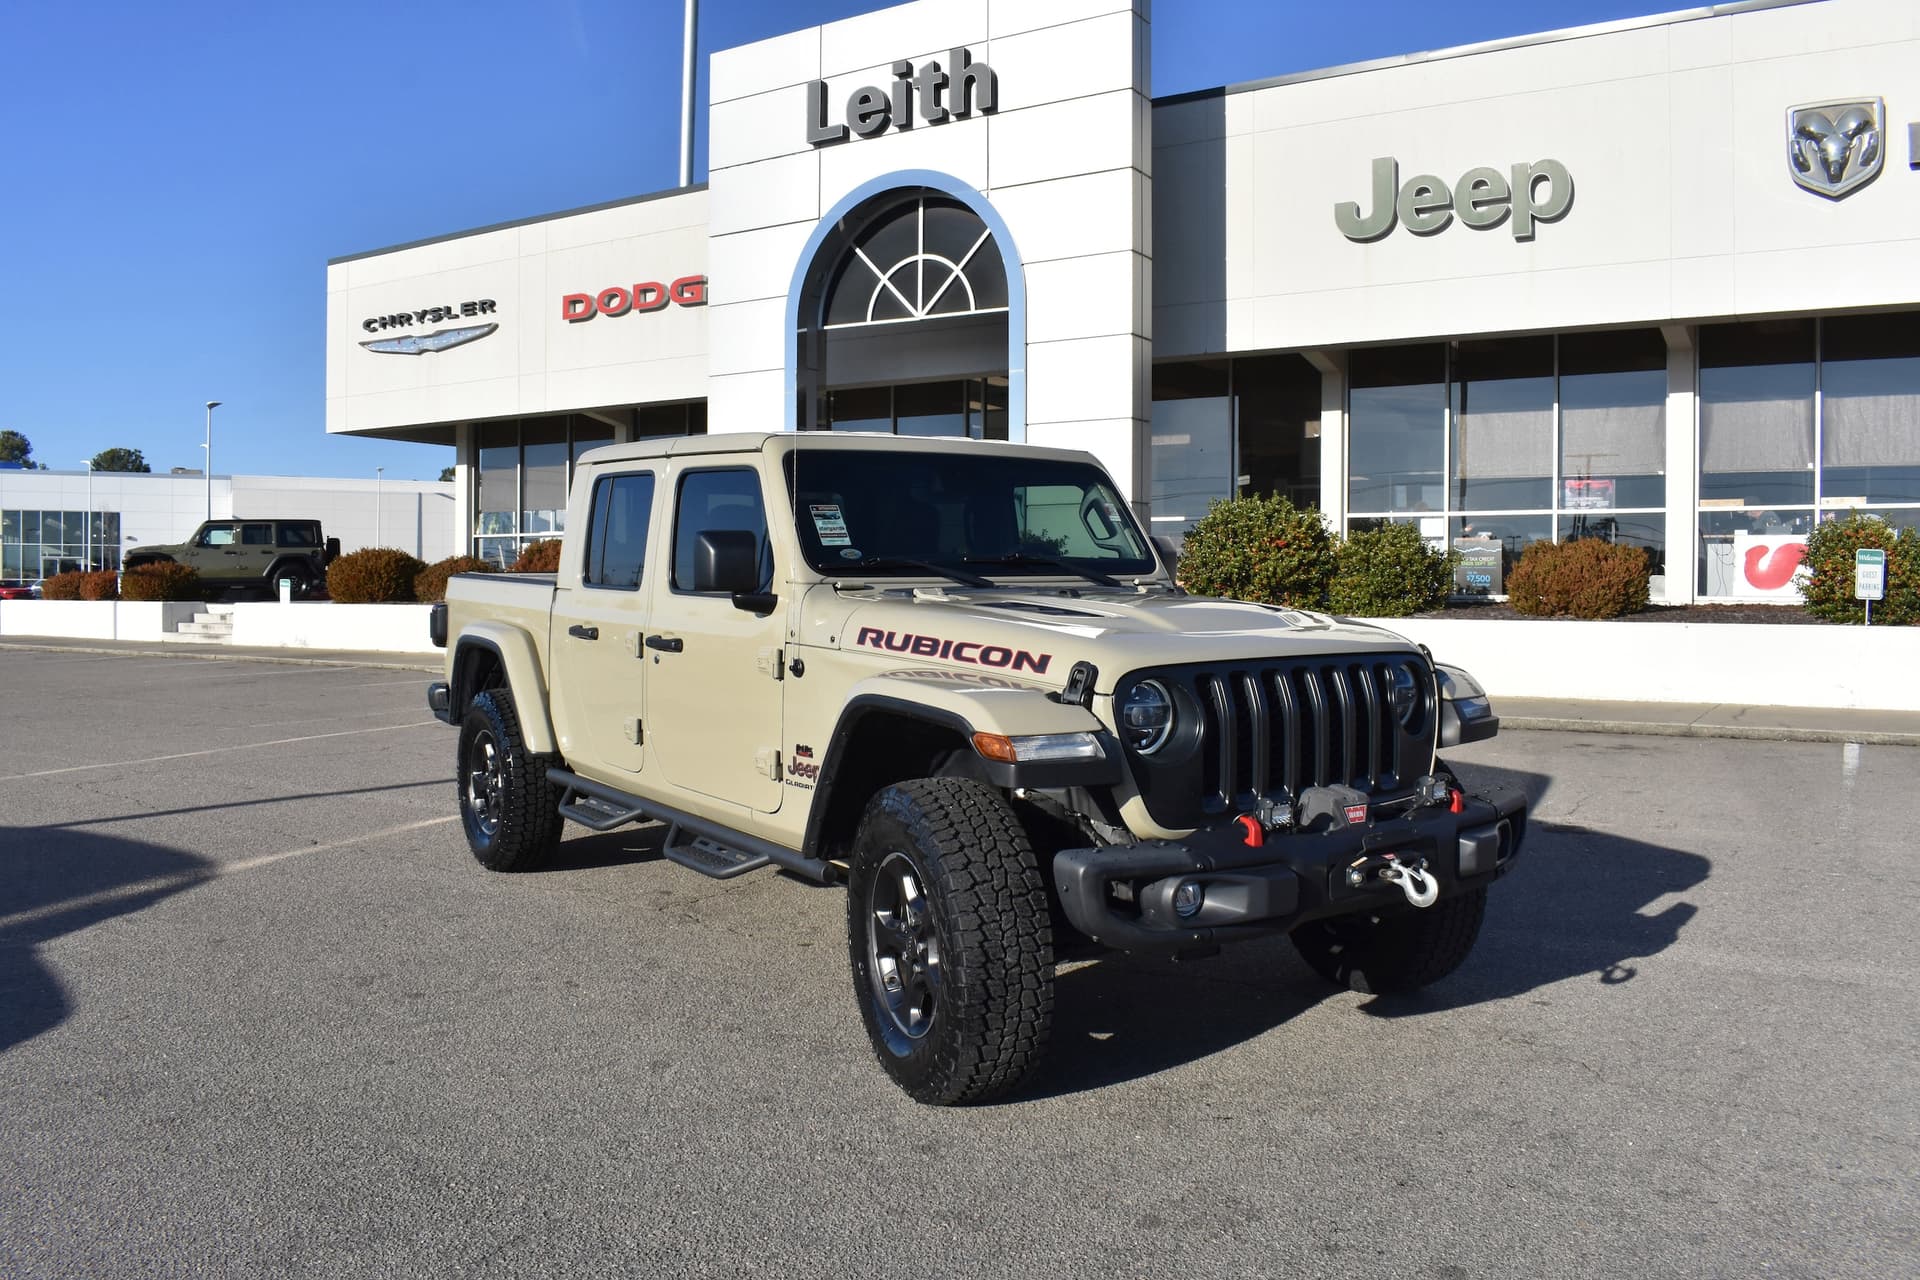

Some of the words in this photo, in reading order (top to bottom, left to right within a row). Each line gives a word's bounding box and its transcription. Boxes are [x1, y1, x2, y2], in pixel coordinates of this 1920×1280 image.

[806, 47, 998, 149] Leith
[1334, 156, 1575, 243] Jeep
[362, 298, 497, 333] CHRYSLER
[1466, 574, 1490, 583] $7,500
[856, 627, 1052, 674] RUBICON
